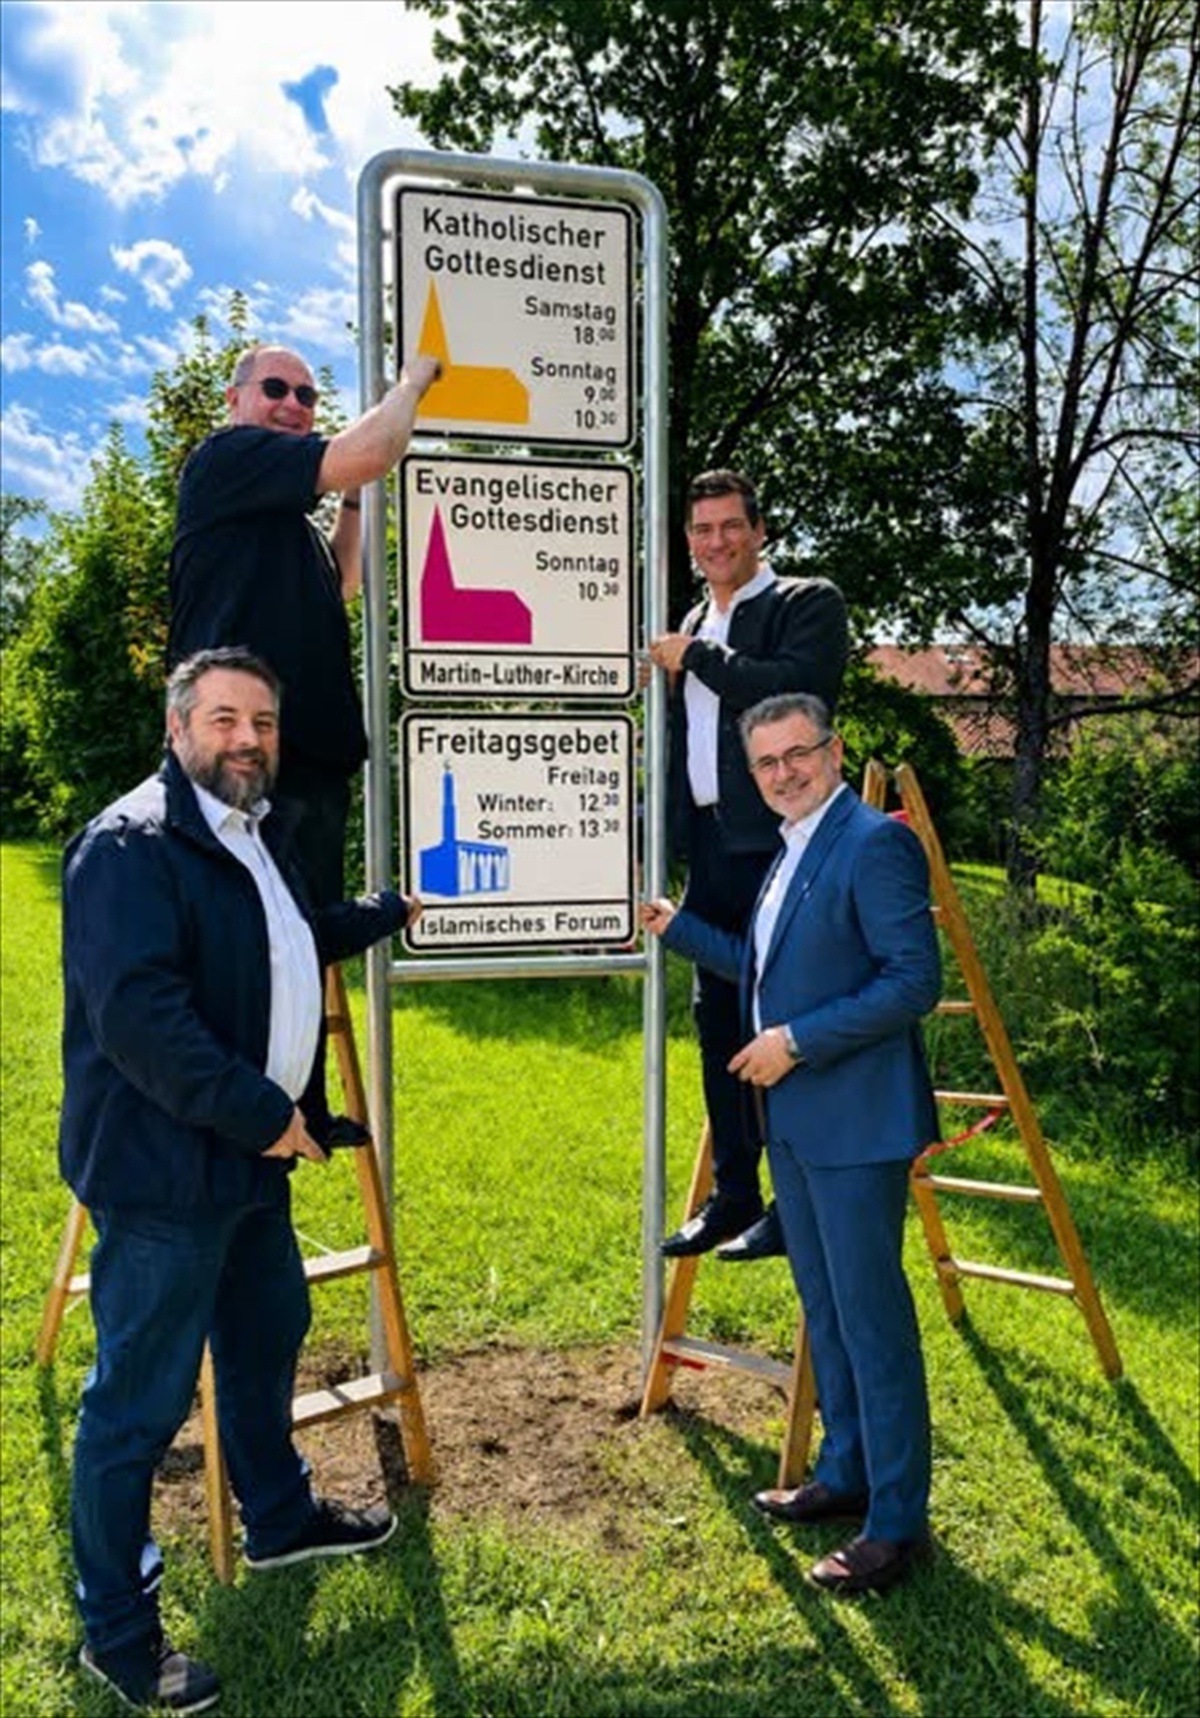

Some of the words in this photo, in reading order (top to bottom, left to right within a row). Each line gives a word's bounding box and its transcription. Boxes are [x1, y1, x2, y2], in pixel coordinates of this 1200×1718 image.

[423, 207, 606, 249] Katholischer
[425, 245, 606, 285] Gottesdienst
[525, 296, 616, 325] Samstag
[531, 356, 616, 383] Sonntag
[416, 469, 617, 503] Evangelischer
[451, 504, 618, 535] Gottesdienst
[535, 551, 619, 577] Sonntag
[421, 662, 618, 686] Martin-Luther-Kirche
[418, 727, 619, 761] Freitagsgebet
[548, 766, 620, 790] Freitag
[477, 793, 553, 812] Winter:
[478, 820, 573, 839] Sommer:
[420, 915, 546, 936] Islamisches
[555, 912, 621, 932] Forum
